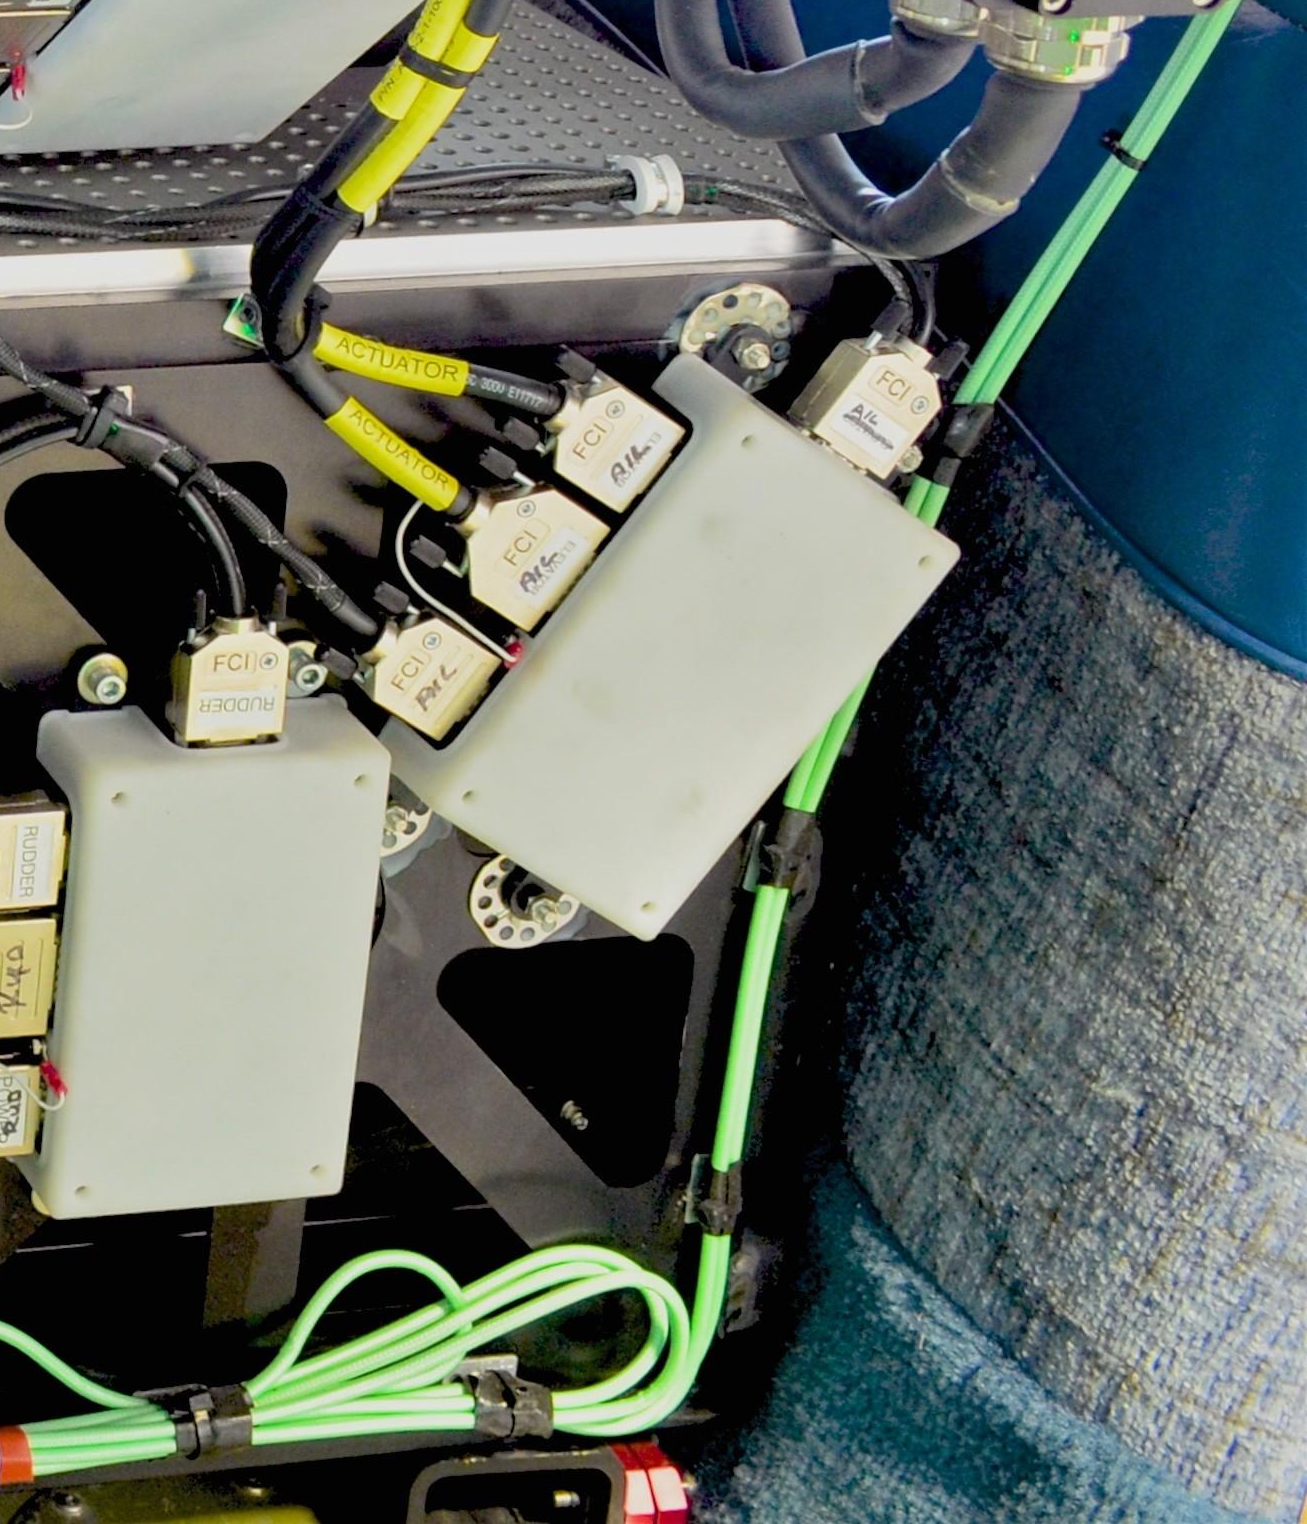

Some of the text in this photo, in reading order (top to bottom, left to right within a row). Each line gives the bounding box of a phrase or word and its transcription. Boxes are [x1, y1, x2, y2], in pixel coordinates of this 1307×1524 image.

[336, 336, 460, 383] ACTUATOR
[875, 369, 912, 401] FCI
[851, 403, 878, 426] AIL
[348, 407, 450, 490] ACTUATOR
[572, 422, 607, 460] FCI
[503, 529, 538, 567] FCI
[213, 652, 249, 673] FCI
[390, 655, 425, 691] FCI
[198, 696, 275, 714] RUDDER
[18, 825, 39, 898] RUDDER
